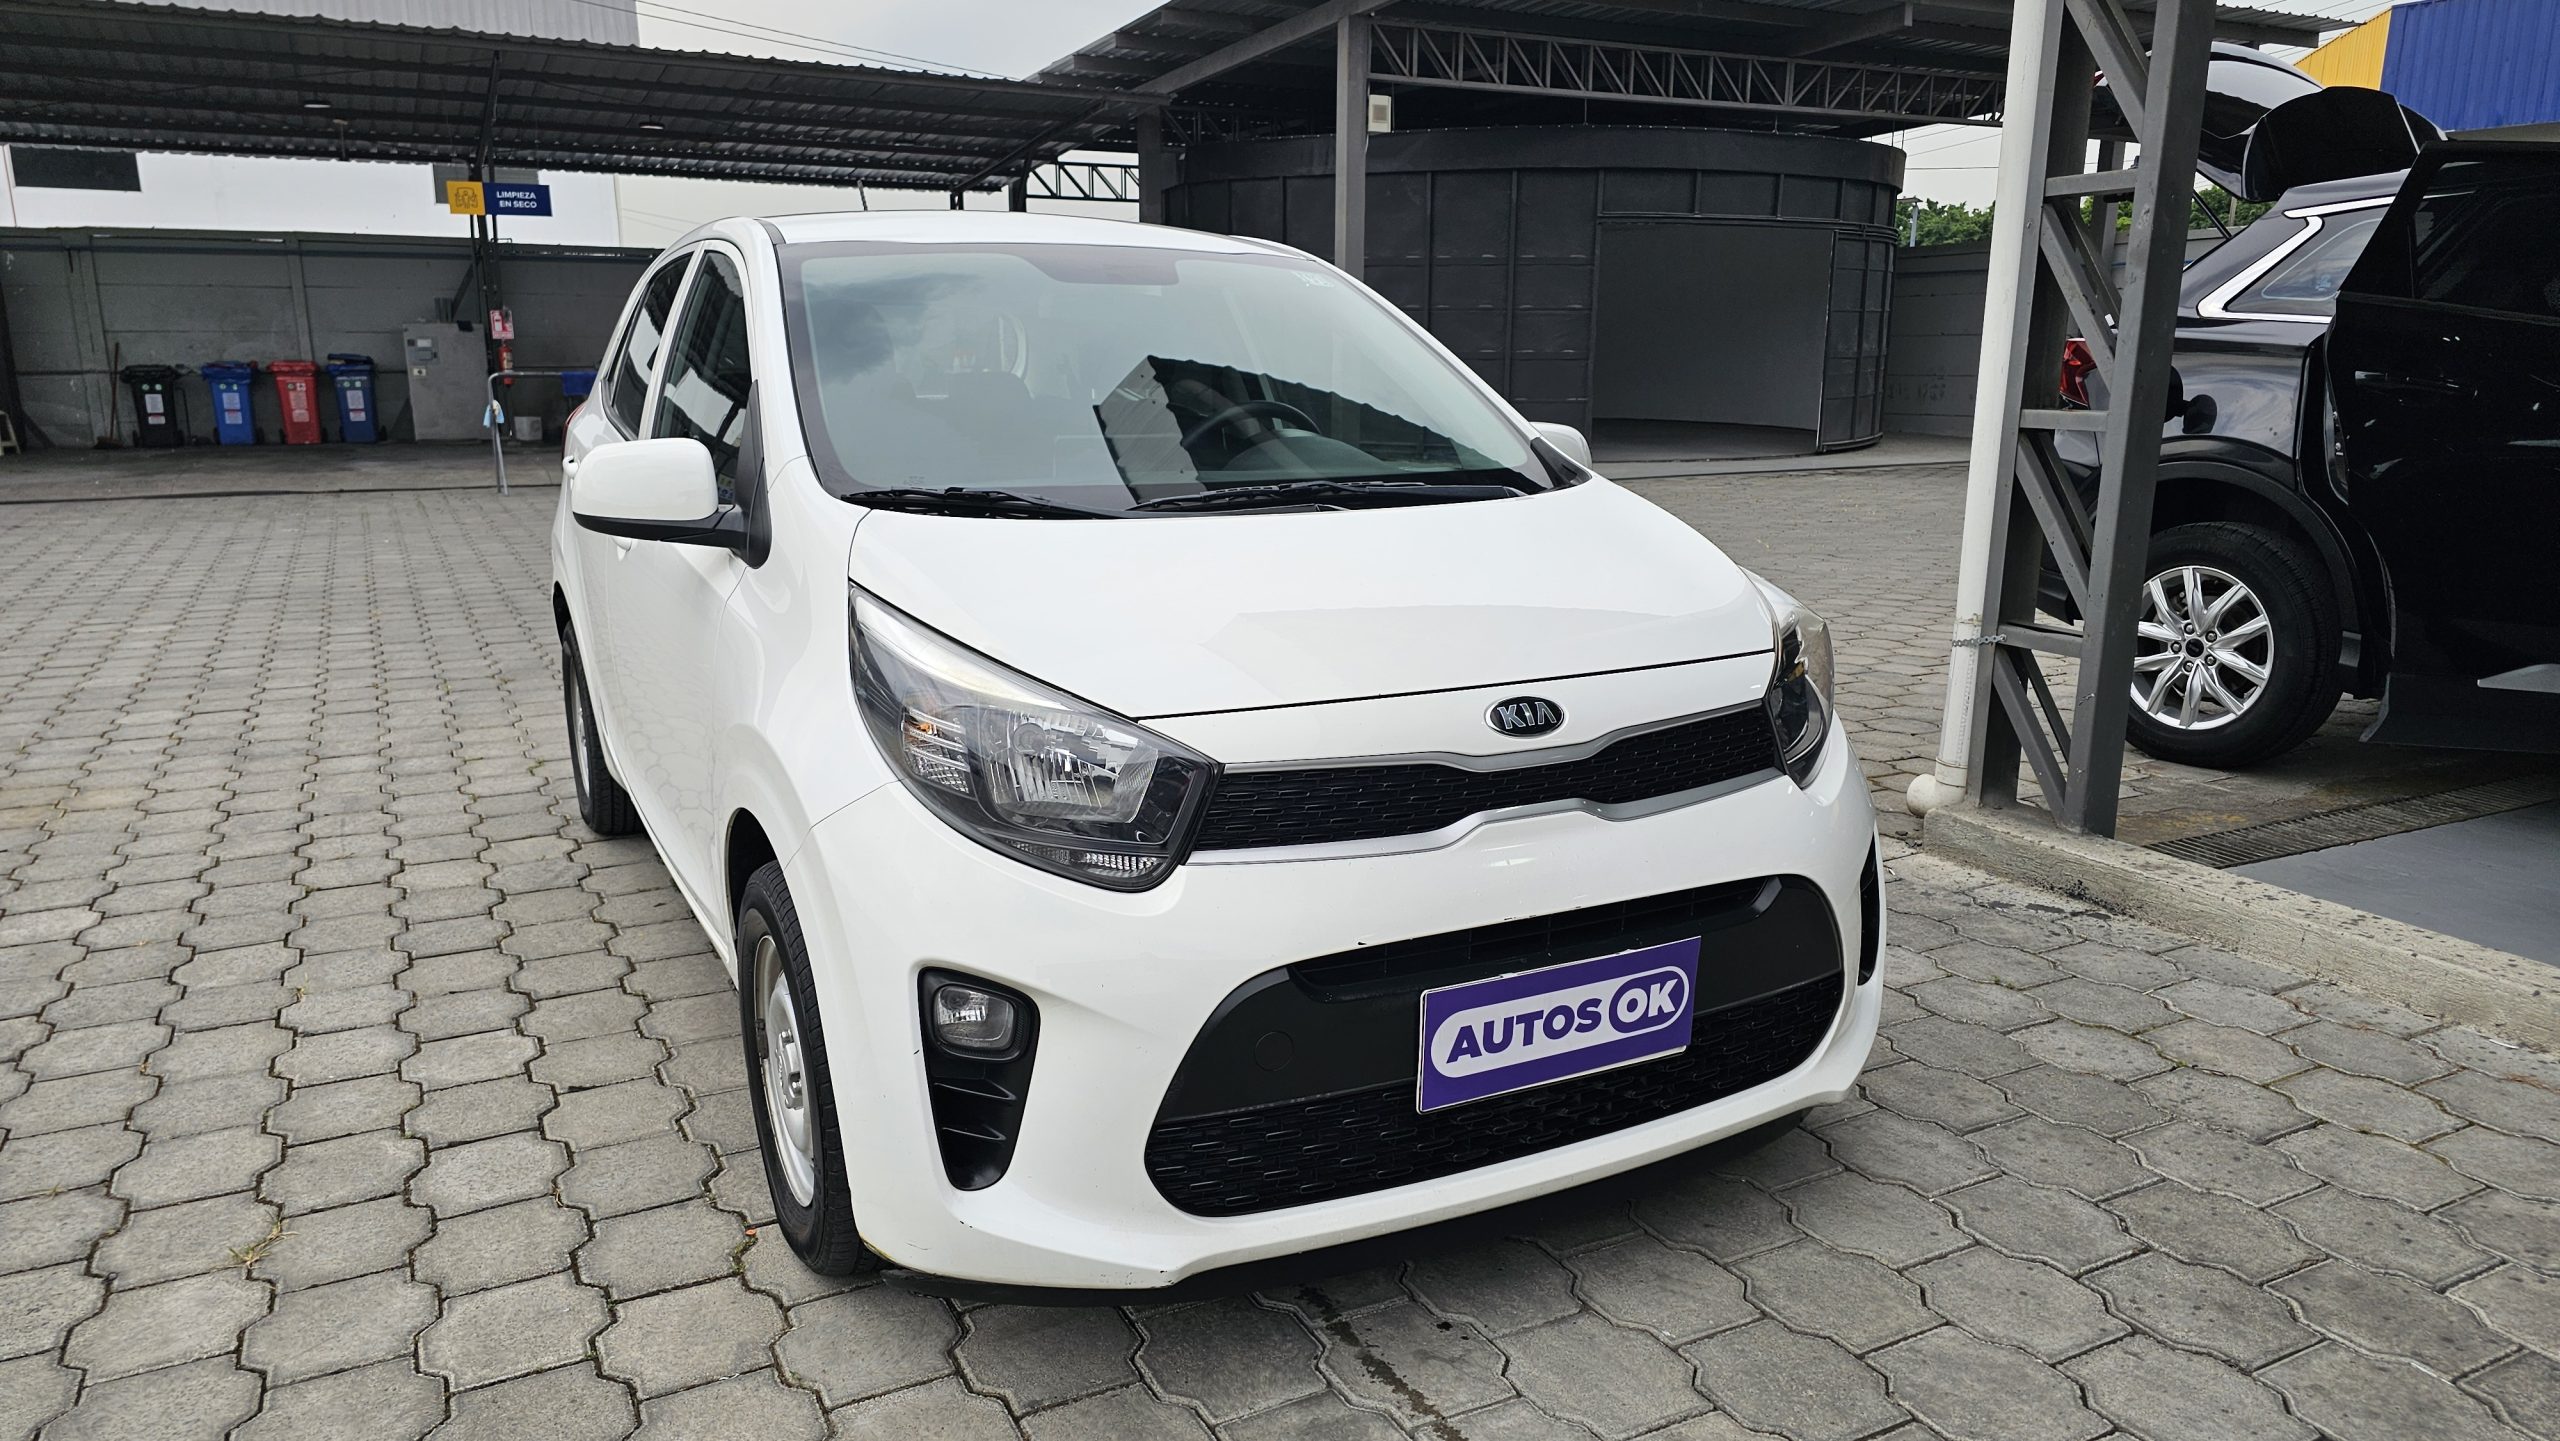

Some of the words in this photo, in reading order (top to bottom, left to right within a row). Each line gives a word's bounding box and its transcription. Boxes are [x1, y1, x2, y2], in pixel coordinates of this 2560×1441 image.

[496, 191, 536, 199] LIMPIEZA
[1497, 701, 1557, 729] KIA
[1446, 998, 1602, 1064] AUTOS
[1616, 979, 1678, 1023] OK
